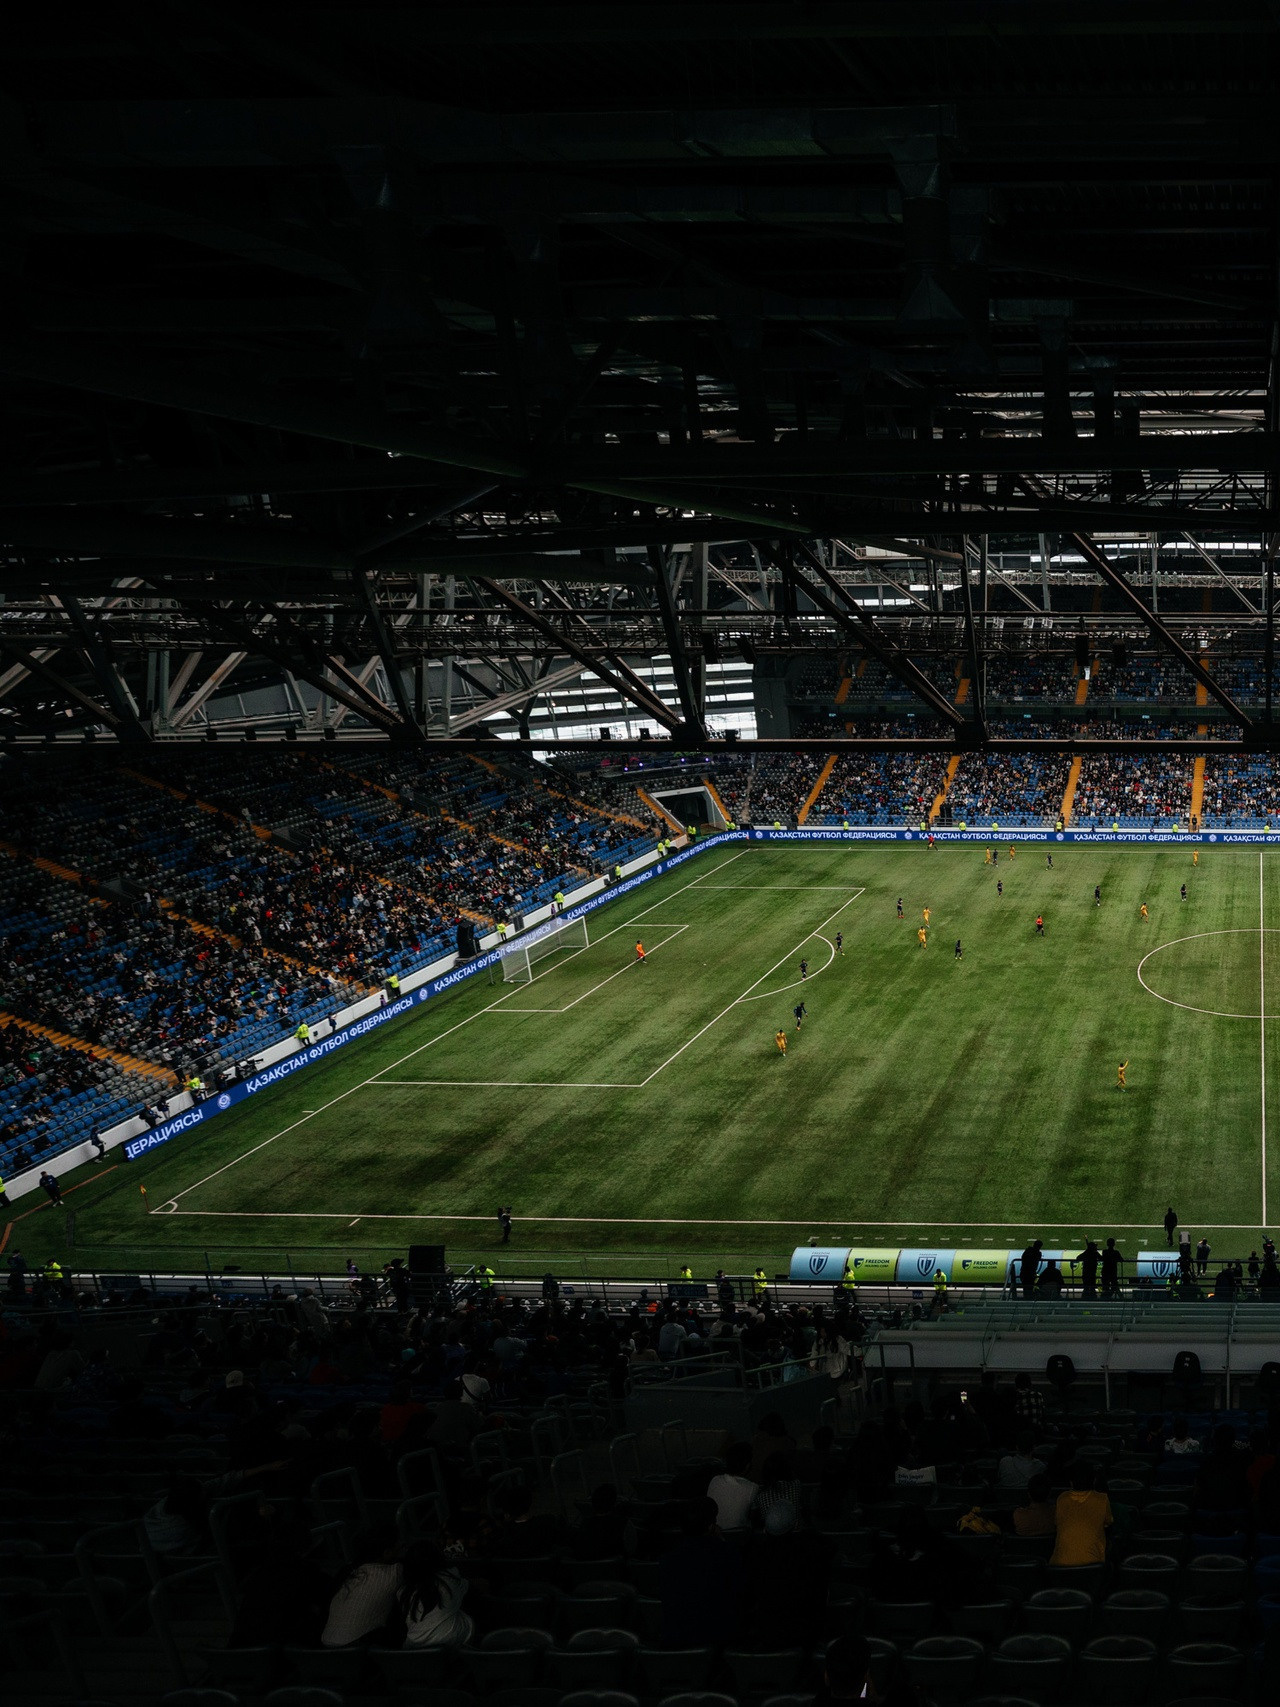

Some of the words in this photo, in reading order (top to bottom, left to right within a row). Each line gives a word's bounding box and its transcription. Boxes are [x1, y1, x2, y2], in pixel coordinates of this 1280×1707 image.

[842, 832, 897, 840] ФЕДЕРАЦИЯСЫ
[961, 832, 991, 840] ФУТБОЛ
[992, 833, 1047, 841] ФЕДЕРАЦИЯСЫ
[1116, 833, 1147, 841] ФУТБОЛ
[1148, 833, 1203, 842] ФЕДЕРАЦИЯСЫ
[434, 965, 477, 992] ҚАЗАҚСТАН
[478, 948, 505, 969] ФУТБОЛ
[246, 1054, 308, 1094] ҚАЗАҚСТАН
[309, 1030, 349, 1059] ФУТБОЛ
[349, 996, 414, 1037] ФЕДЕРАЦИЯСЫ
